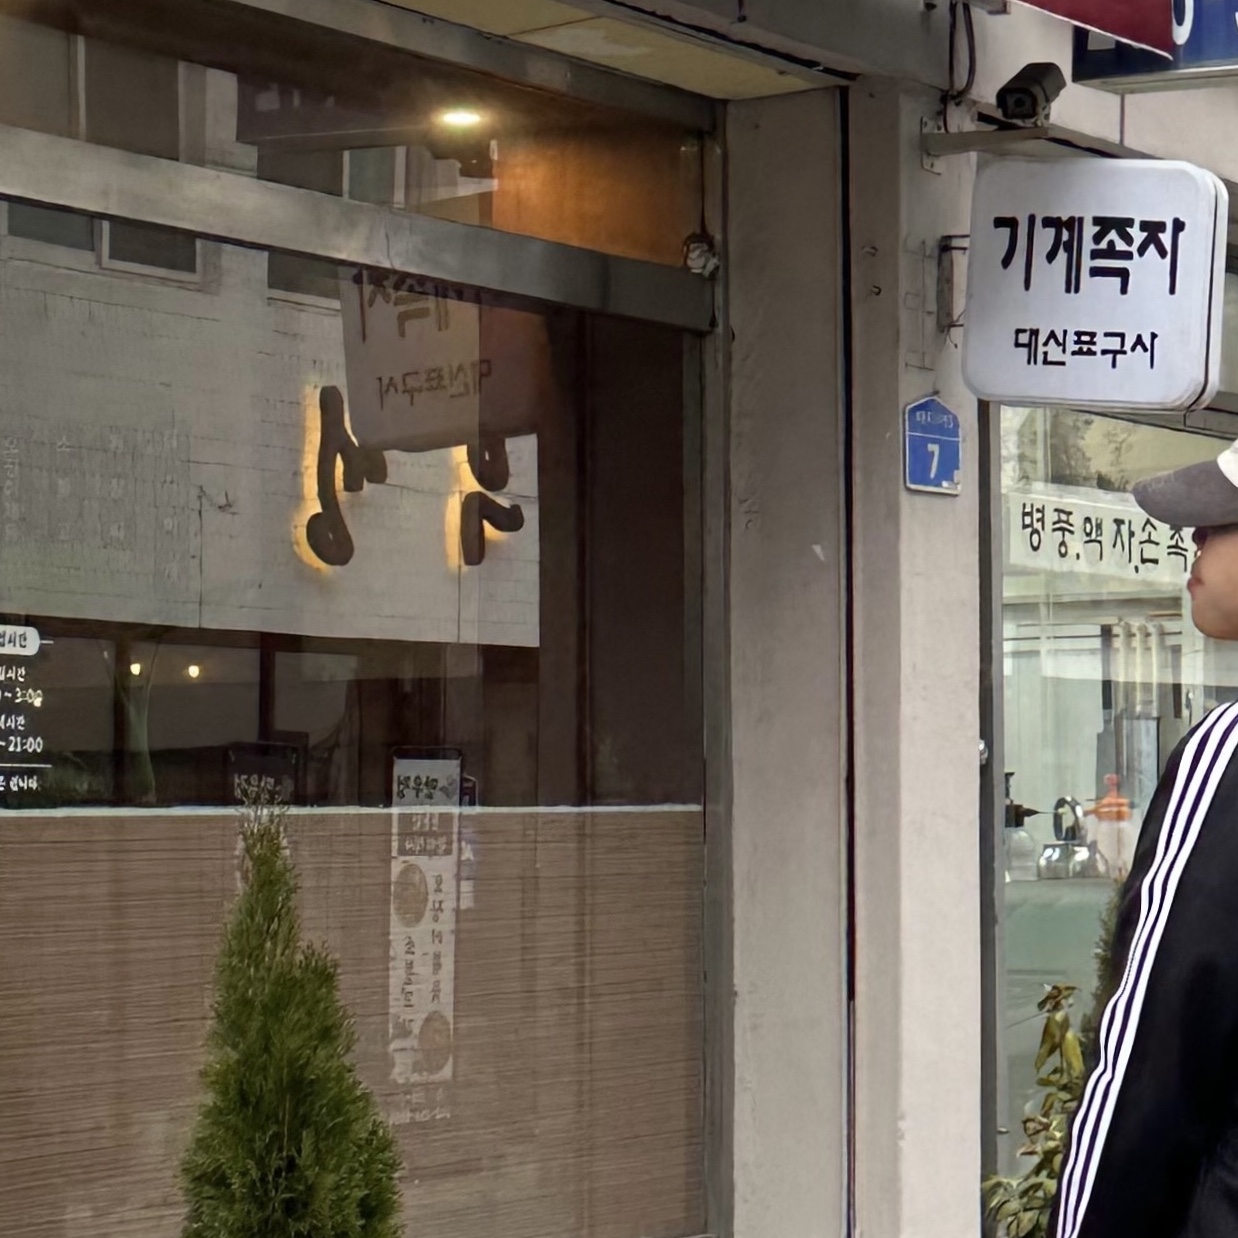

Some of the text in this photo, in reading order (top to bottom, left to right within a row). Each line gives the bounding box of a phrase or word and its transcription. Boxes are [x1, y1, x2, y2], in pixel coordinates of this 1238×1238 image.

[993, 213, 1186, 296] 기계족자
[1013, 327, 1158, 370] 대신표구사
[927, 443, 940, 479] 7
